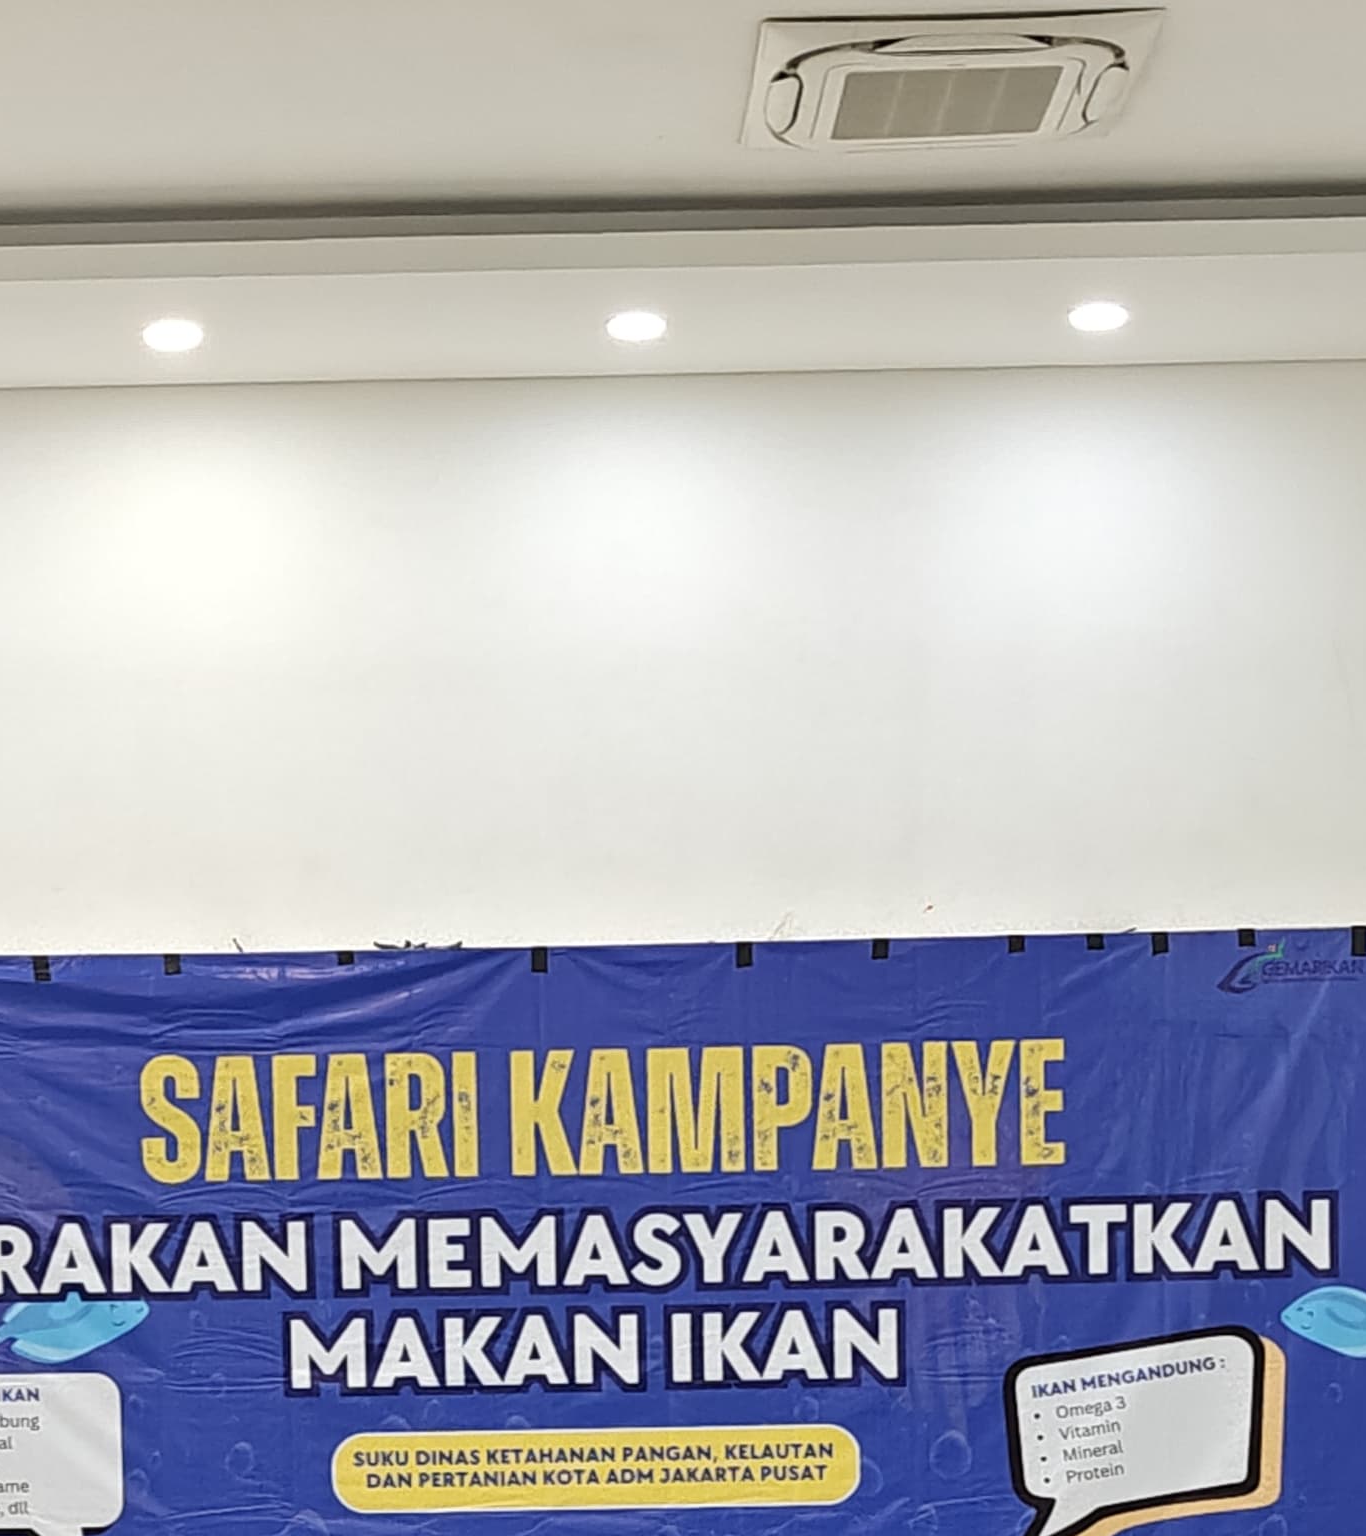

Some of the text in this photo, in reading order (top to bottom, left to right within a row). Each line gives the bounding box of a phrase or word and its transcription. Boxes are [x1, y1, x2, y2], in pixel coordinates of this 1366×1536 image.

[139, 1038, 1066, 1184] SAFARI KAMPANYE
[339, 1198, 1332, 1289] MEMASYARAKATKAN
[289, 1307, 901, 1390] MAKAN IKAN
[1032, 1380, 1077, 1399] IKAN
[1081, 1357, 1216, 1391] MENGANDUNG
[1055, 1396, 1127, 1419] Omega 3
[1059, 1420, 1122, 1441] Vitamin
[353, 1442, 834, 1468] SUKU DINAS KETAHANAN PANGAN, KELAUTAN
[1063, 1441, 1124, 1463] Mineral
[366, 1464, 828, 1489] DAN PERTANIAN KOTA ADM JAKARTA PUSAT
[1066, 1463, 1125, 1484] Protein
[8, 1501, 29, 1515] dll
